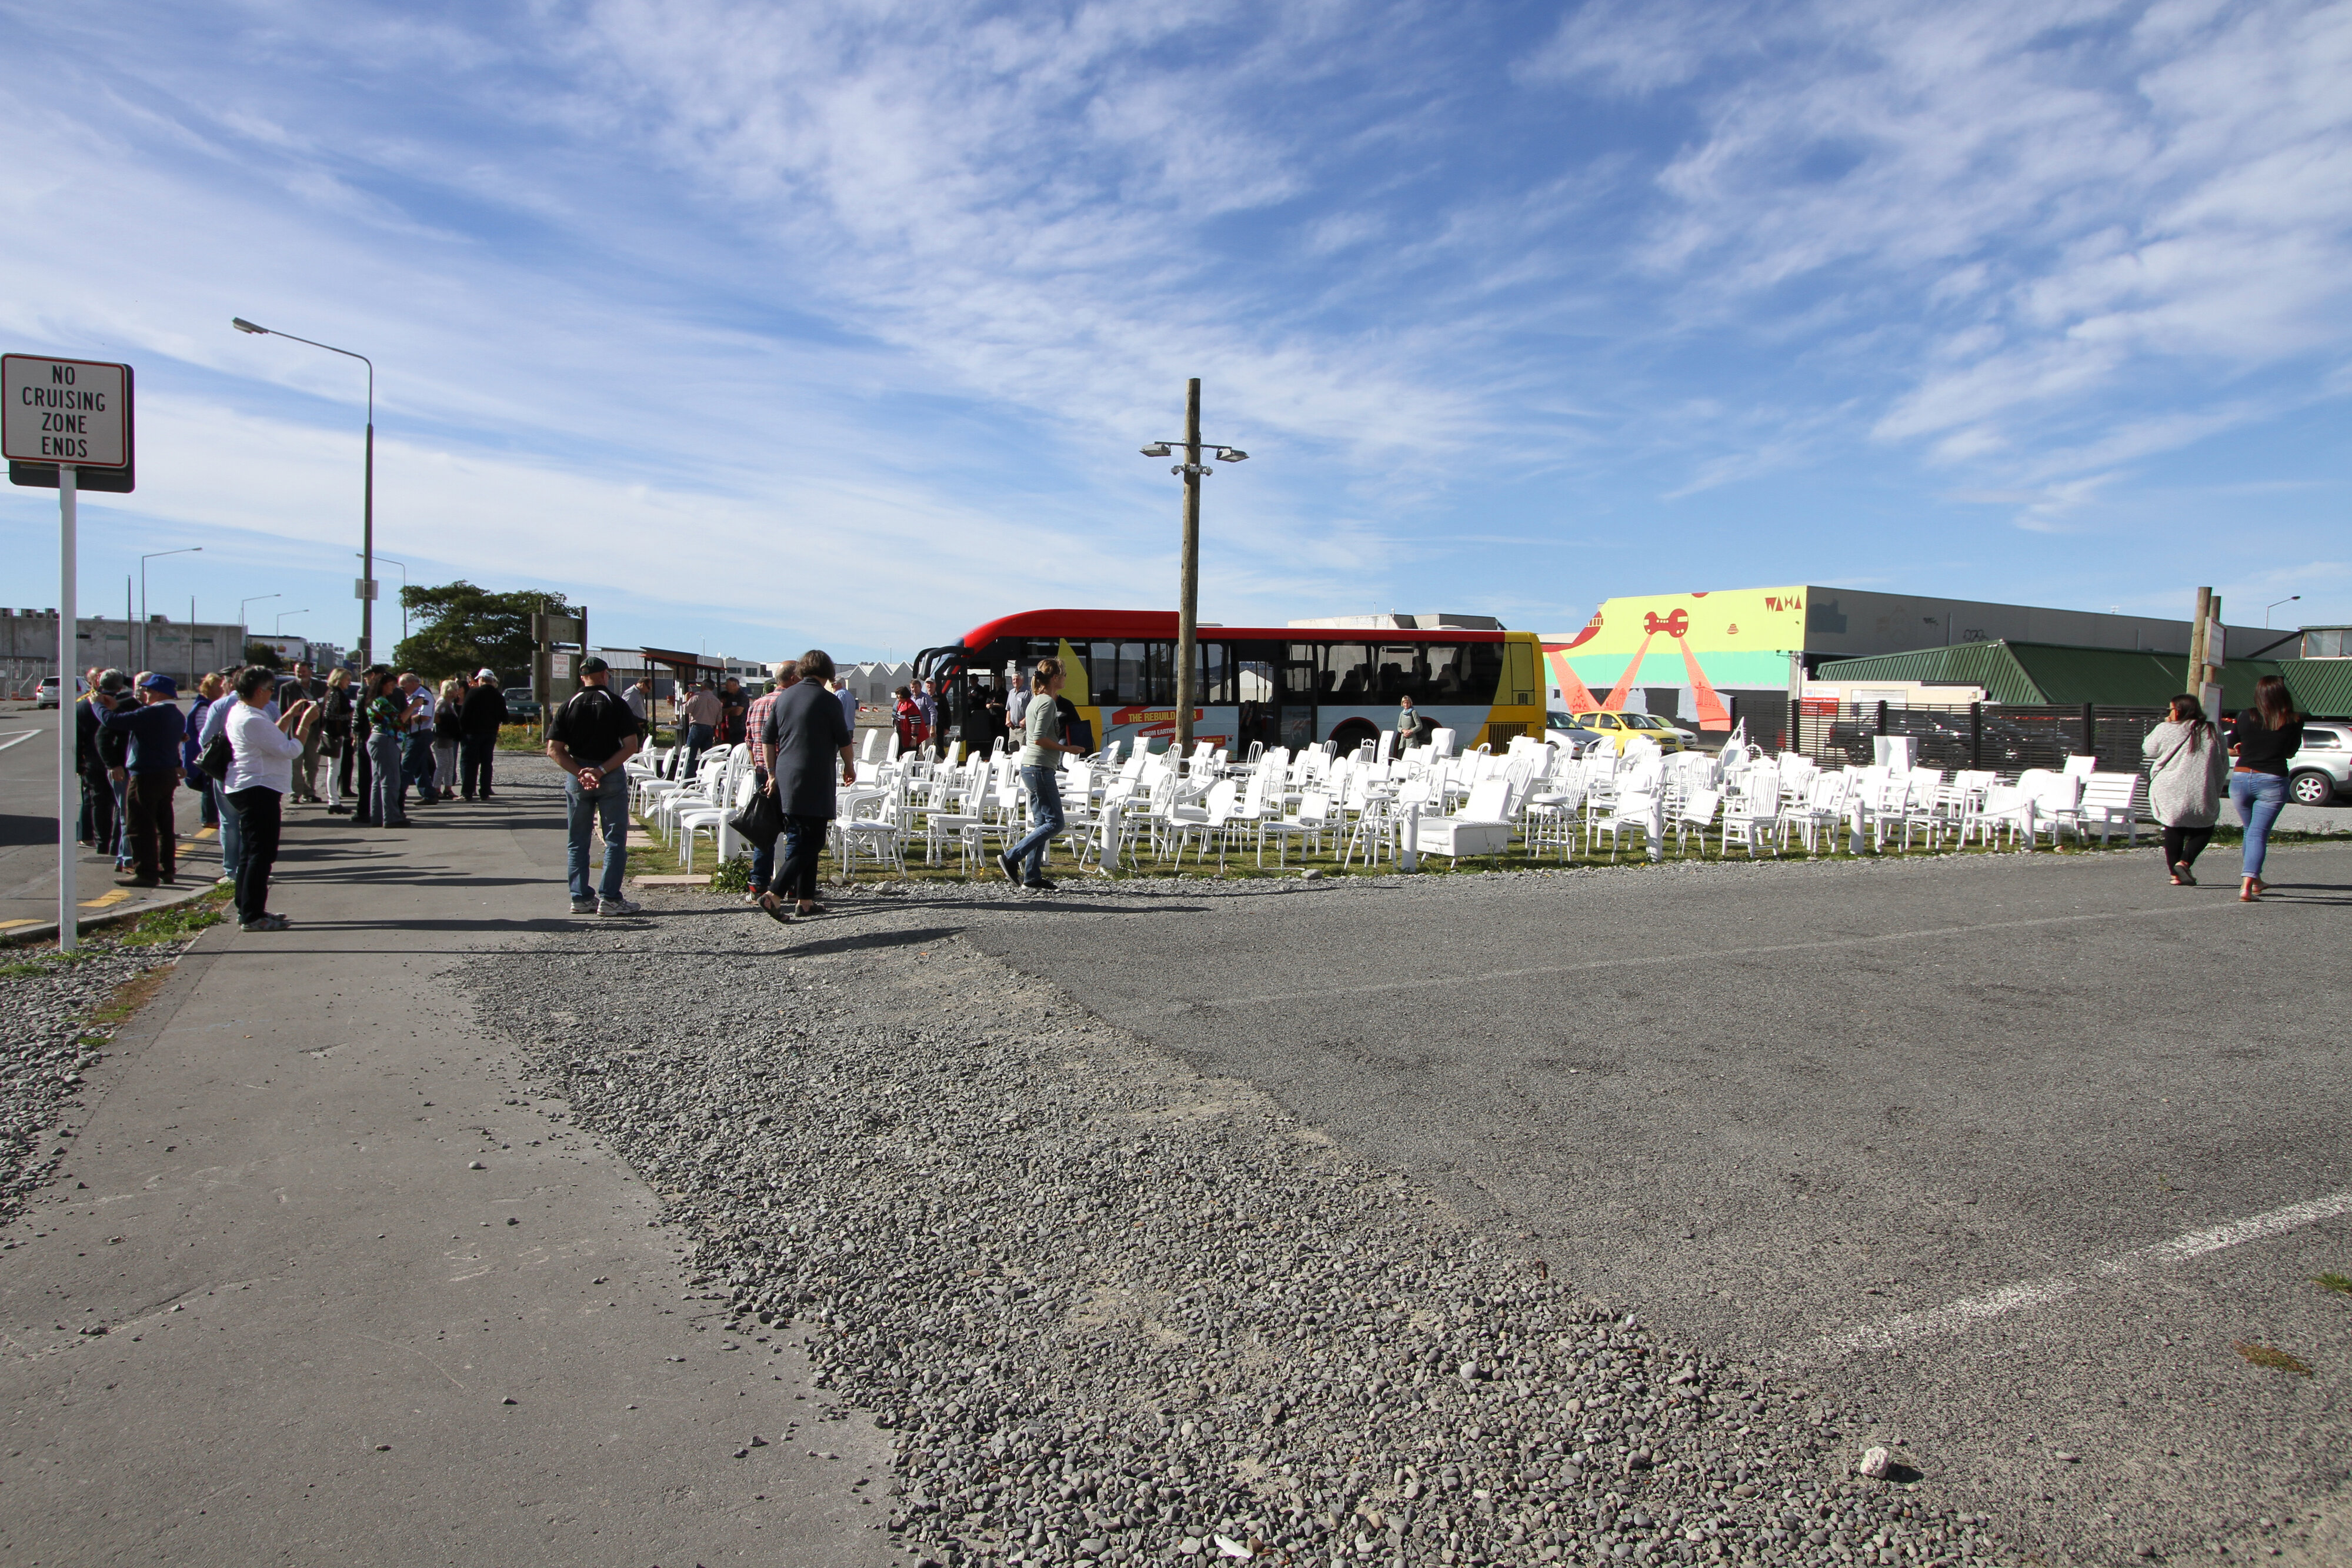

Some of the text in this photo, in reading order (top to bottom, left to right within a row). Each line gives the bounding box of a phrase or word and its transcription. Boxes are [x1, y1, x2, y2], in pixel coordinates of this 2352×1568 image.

[52, 365, 75, 385] NO
[22, 386, 106, 412] CRUISING
[42, 412, 88, 434] ZONE
[42, 436, 88, 458] ENDS
[1128, 712, 1176, 722] THE REBUILD
